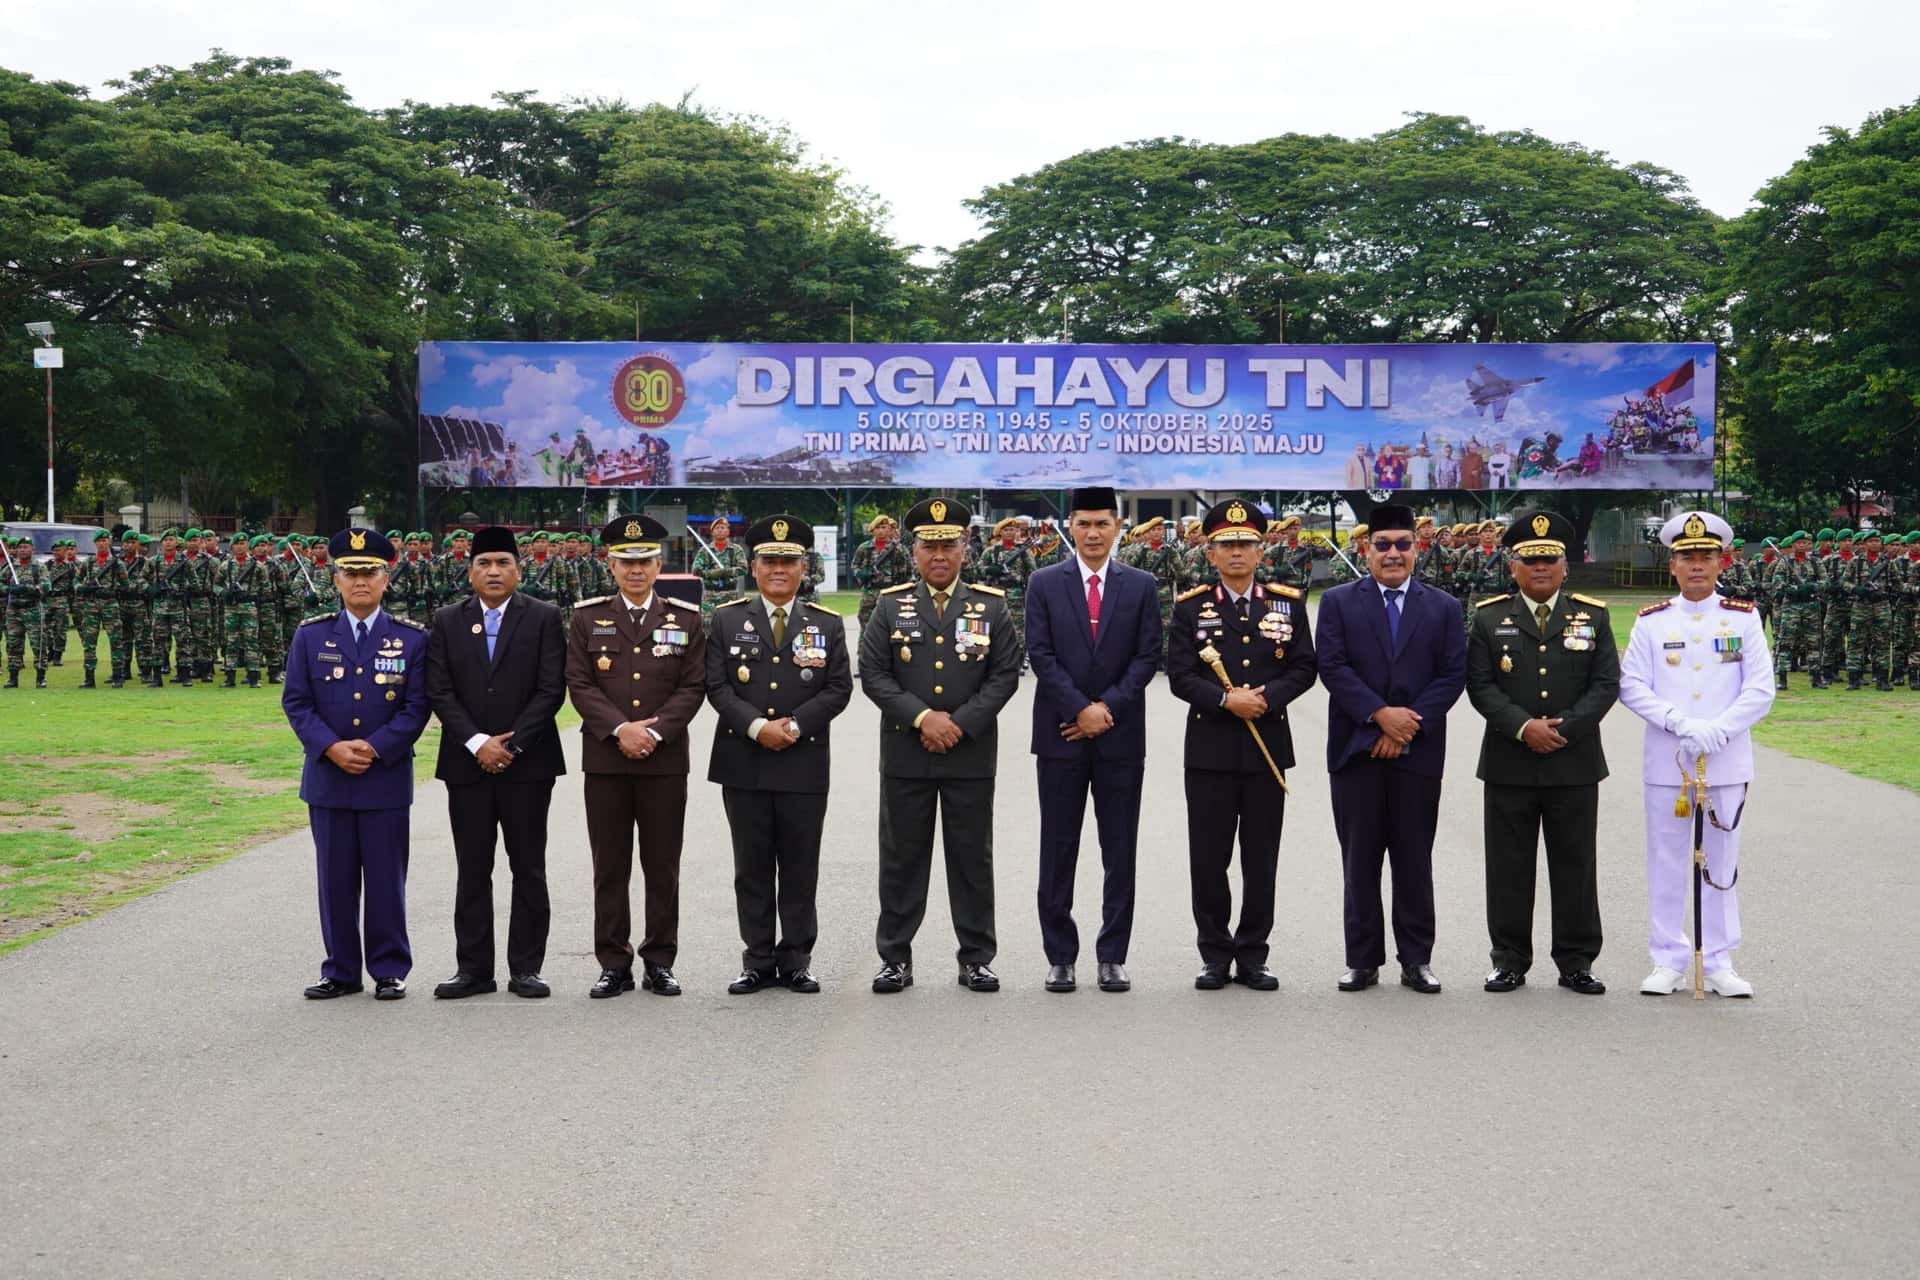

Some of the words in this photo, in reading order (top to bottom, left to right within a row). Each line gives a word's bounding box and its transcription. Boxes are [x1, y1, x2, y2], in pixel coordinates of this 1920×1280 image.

[625, 369, 673, 412] 80
[736, 356, 1226, 407] DIRGAHAYU
[1248, 358, 1389, 407] TNI
[857, 412, 870, 430] 5
[879, 412, 986, 430] OKTOBER
[997, 412, 1050, 430] 1945
[1079, 412, 1091, 430] 5
[1100, 412, 1208, 431] OKTOBER
[1218, 414, 1273, 432] 2025
[804, 433, 841, 451] TNI
[850, 433, 927, 451] PRIMA
[953, 433, 989, 451] TNI
[998, 433, 1091, 452] RAKYAT
[1116, 434, 1246, 453] INDONESIA
[1254, 435, 1324, 454] MAJU
